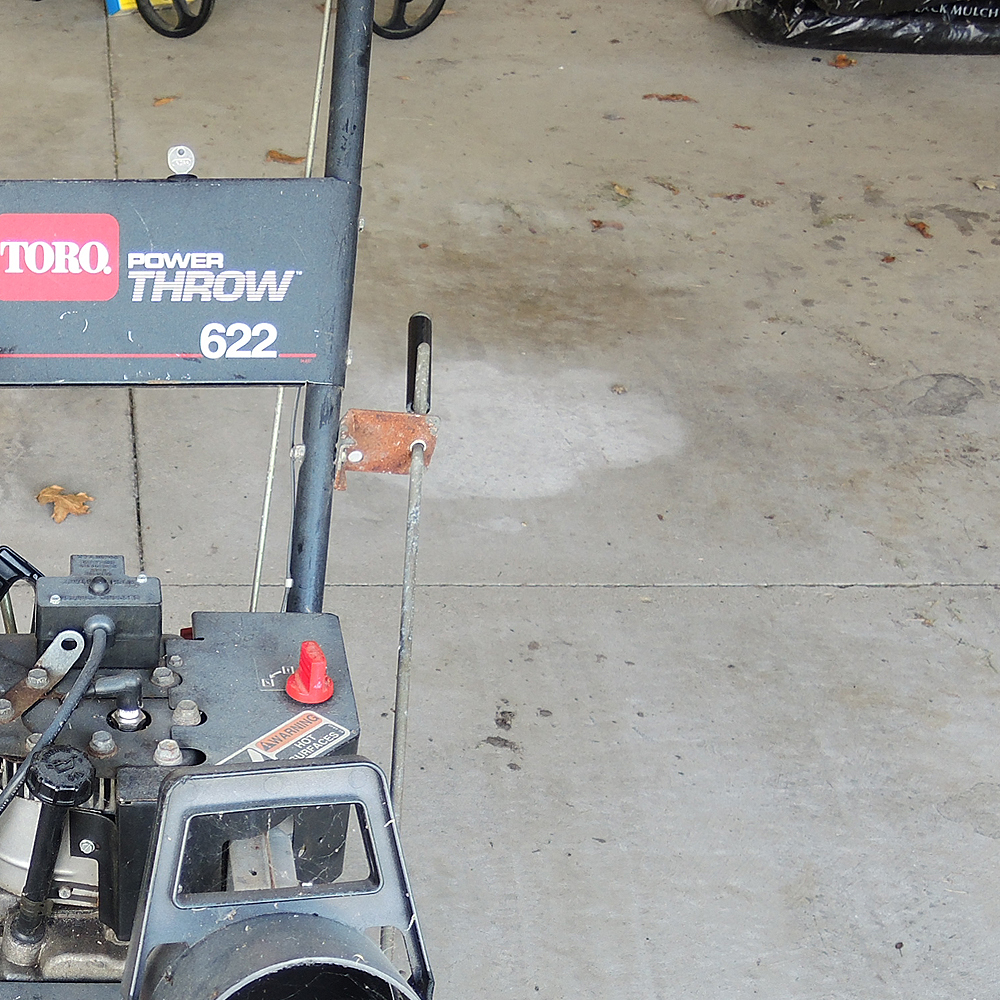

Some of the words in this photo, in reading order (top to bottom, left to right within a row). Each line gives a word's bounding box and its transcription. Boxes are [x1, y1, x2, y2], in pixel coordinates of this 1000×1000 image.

[950, 4, 999, 18] MULCH
[127, 252, 224, 269] POWER
[200, 322, 278, 359] 622
[270, 713, 320, 745] WARNING
[293, 734, 317, 749] HOT
